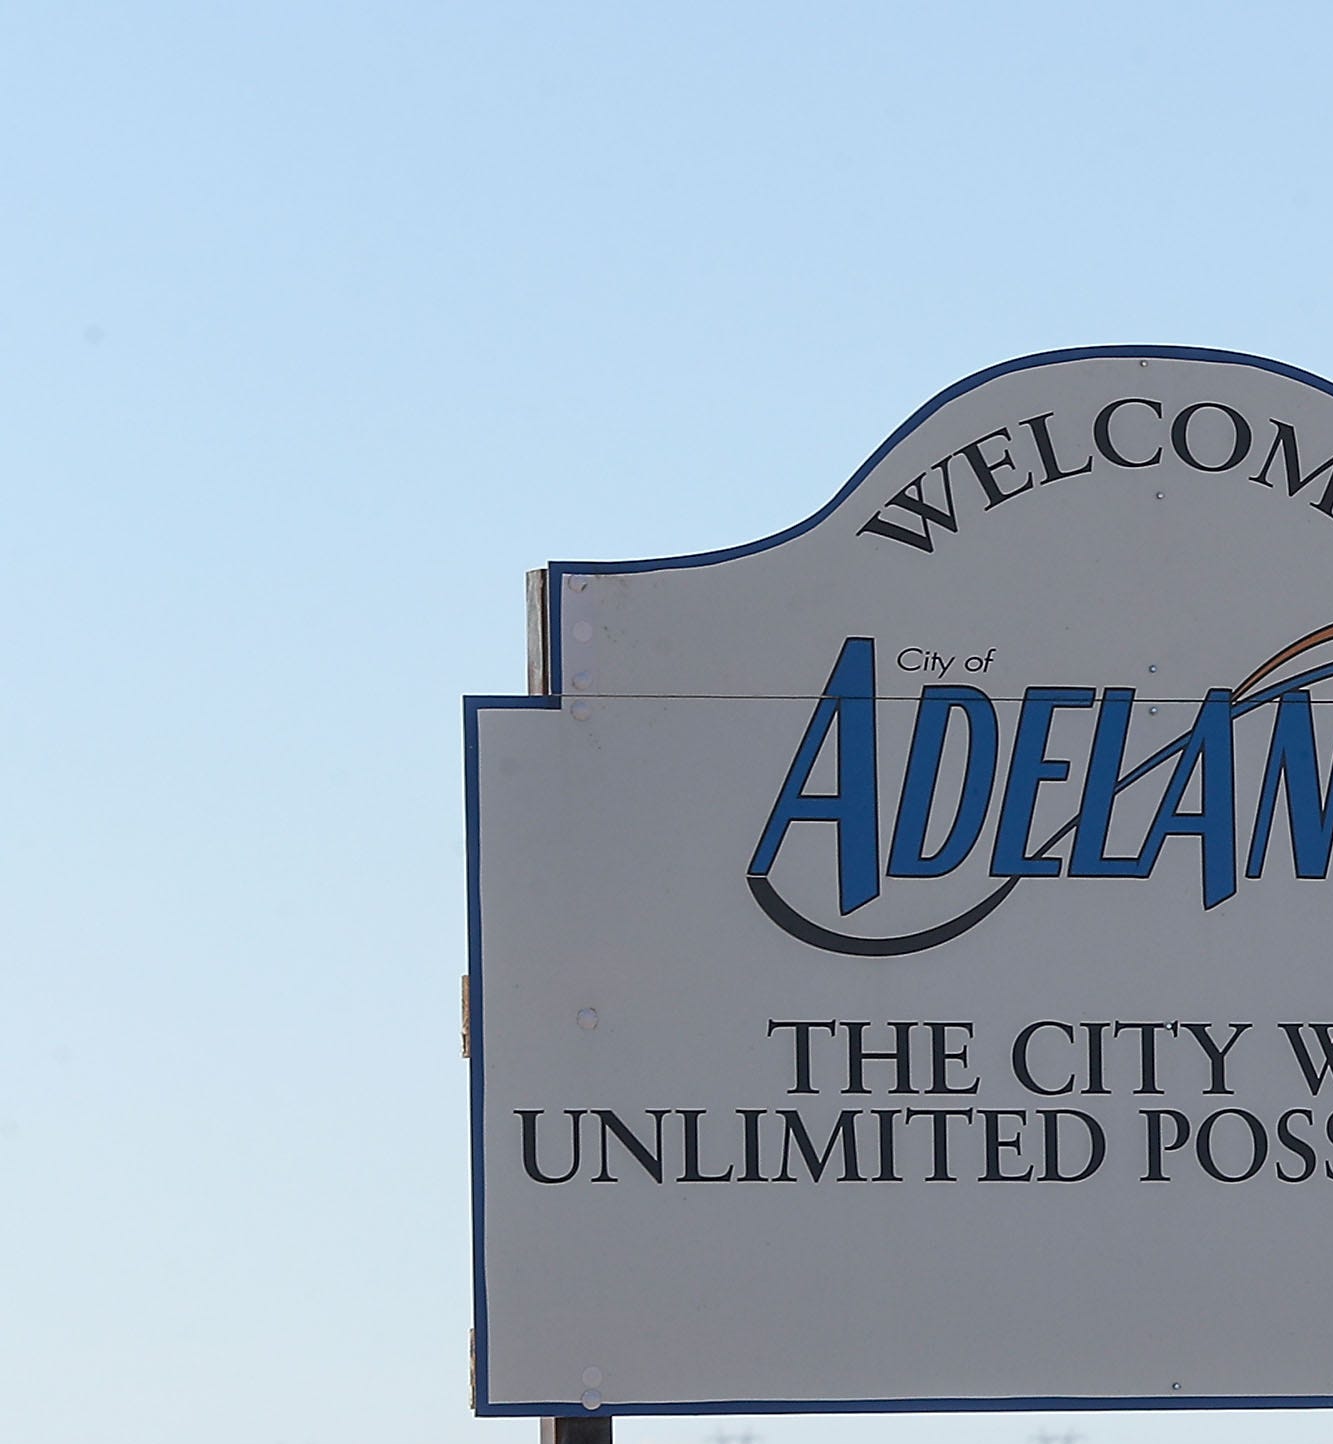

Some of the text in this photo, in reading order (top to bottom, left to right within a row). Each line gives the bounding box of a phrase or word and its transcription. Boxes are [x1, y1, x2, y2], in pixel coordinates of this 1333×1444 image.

[897, 647, 997, 679] City of
[769, 1020, 981, 1096] THE
[1013, 1020, 1253, 1097] CITY
[514, 1108, 1107, 1185] UNLIMITED
